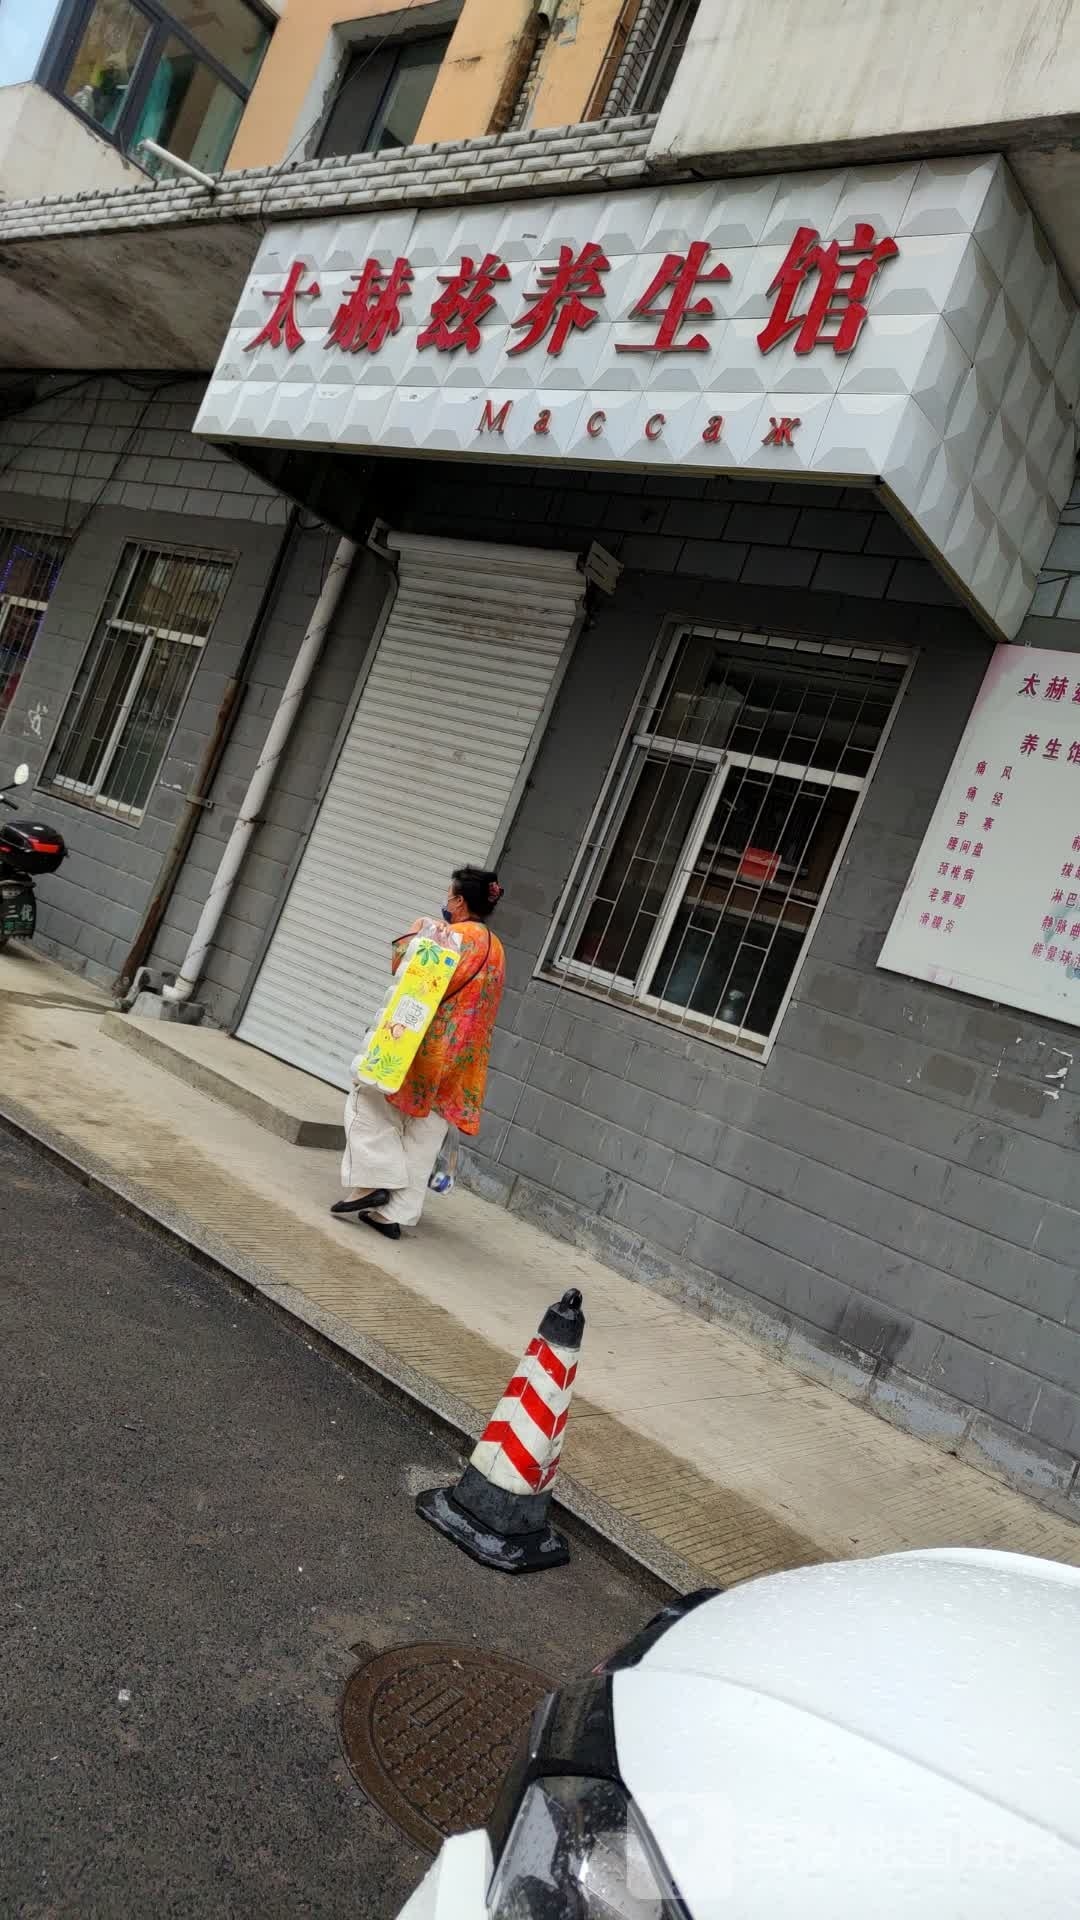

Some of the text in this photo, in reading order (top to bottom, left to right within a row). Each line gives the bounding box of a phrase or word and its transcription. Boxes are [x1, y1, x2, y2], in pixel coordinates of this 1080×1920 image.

[242, 223, 900, 357] 太赫兹养生馆
[477, 397, 802, 449] Массаж
[937, 862, 975, 883] 颈椎病
[1050, 888, 1080, 909] 淋巴
